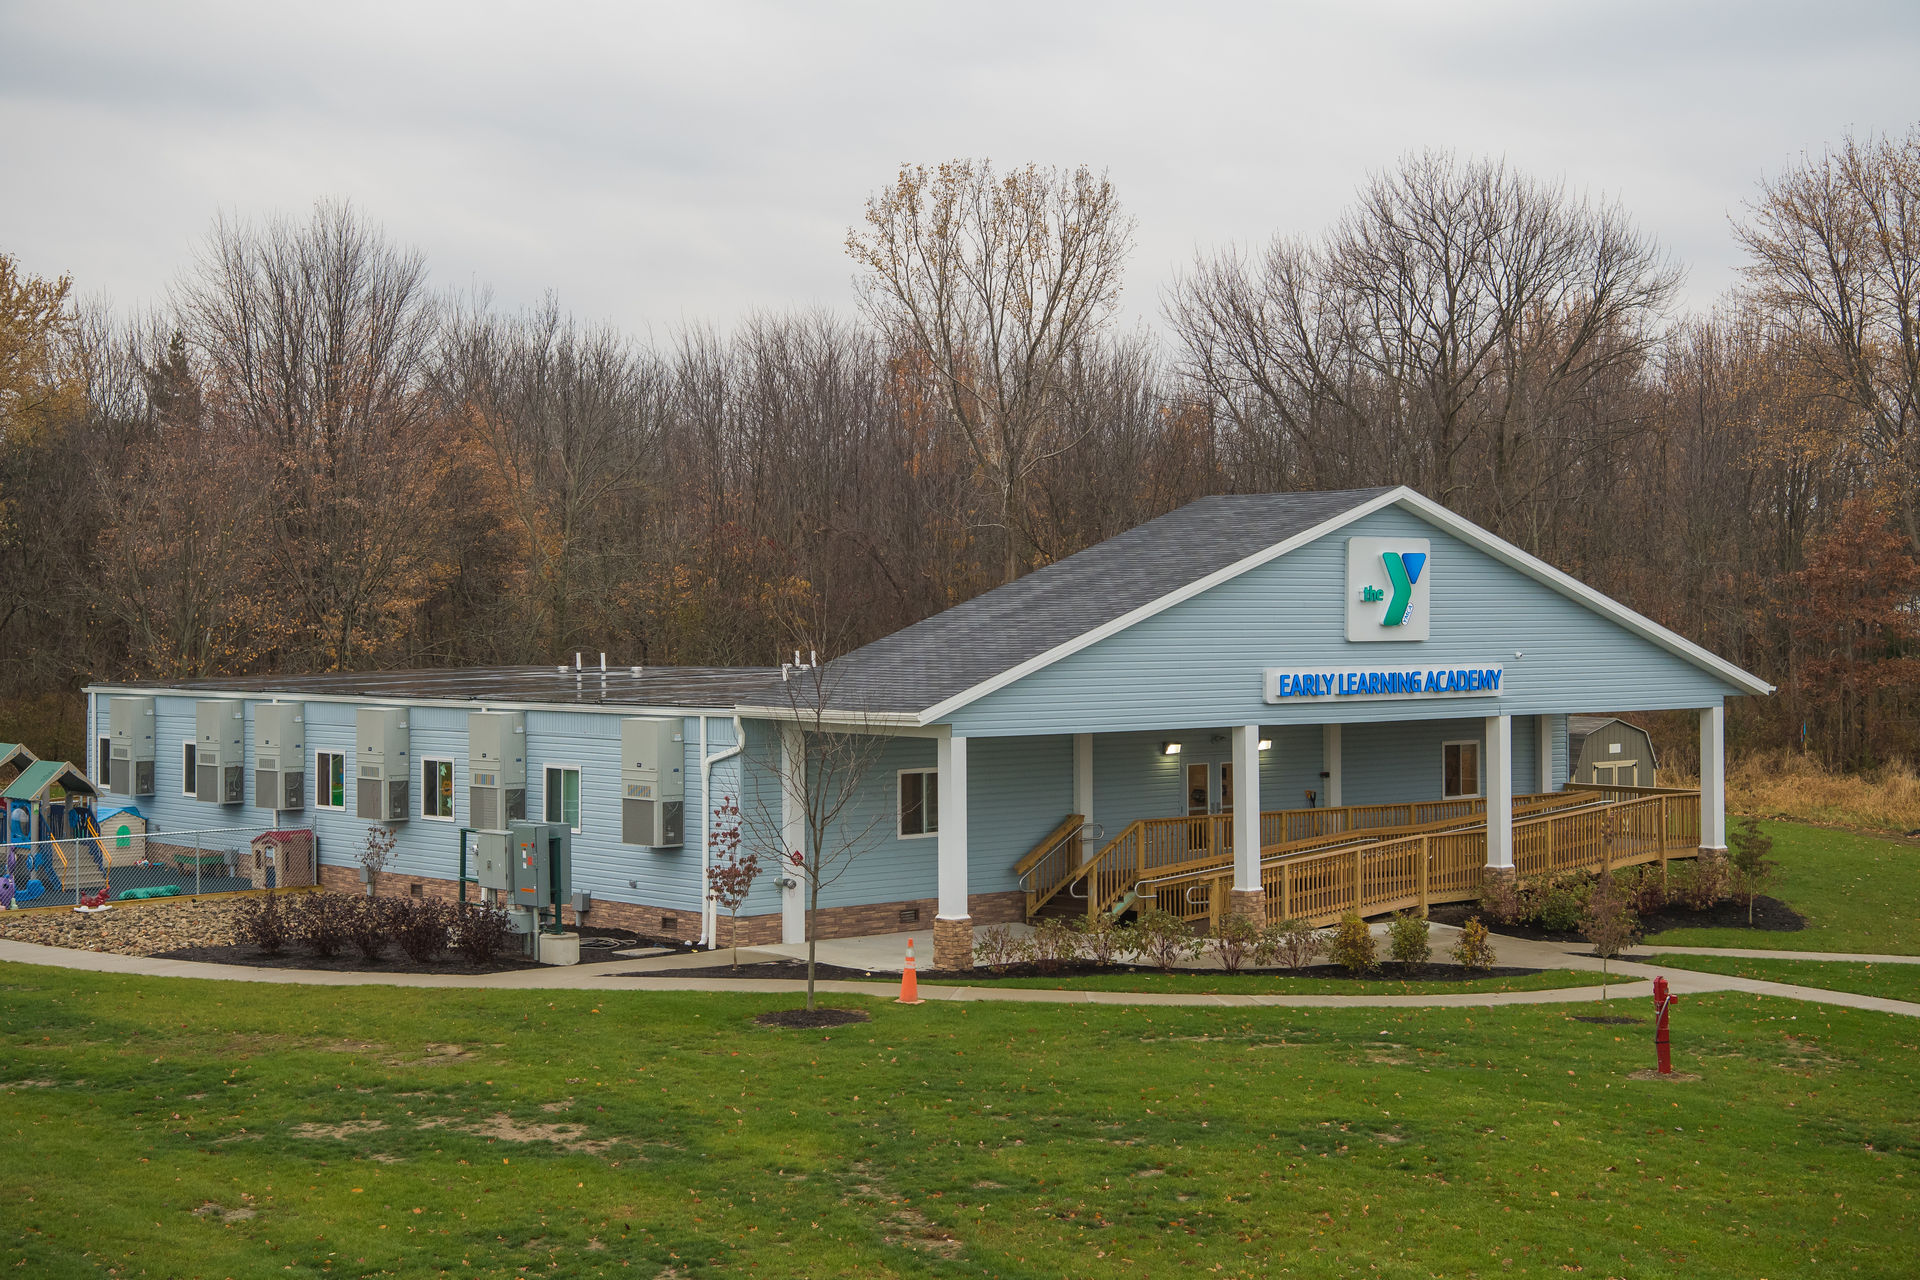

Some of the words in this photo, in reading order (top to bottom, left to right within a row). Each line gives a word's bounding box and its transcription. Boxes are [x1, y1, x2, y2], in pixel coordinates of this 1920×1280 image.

[1363, 585, 1384, 602] the
[1280, 673, 1335, 697] EARLY
[1338, 671, 1422, 695] LEARNING
[1424, 669, 1502, 692] ACADEMY
